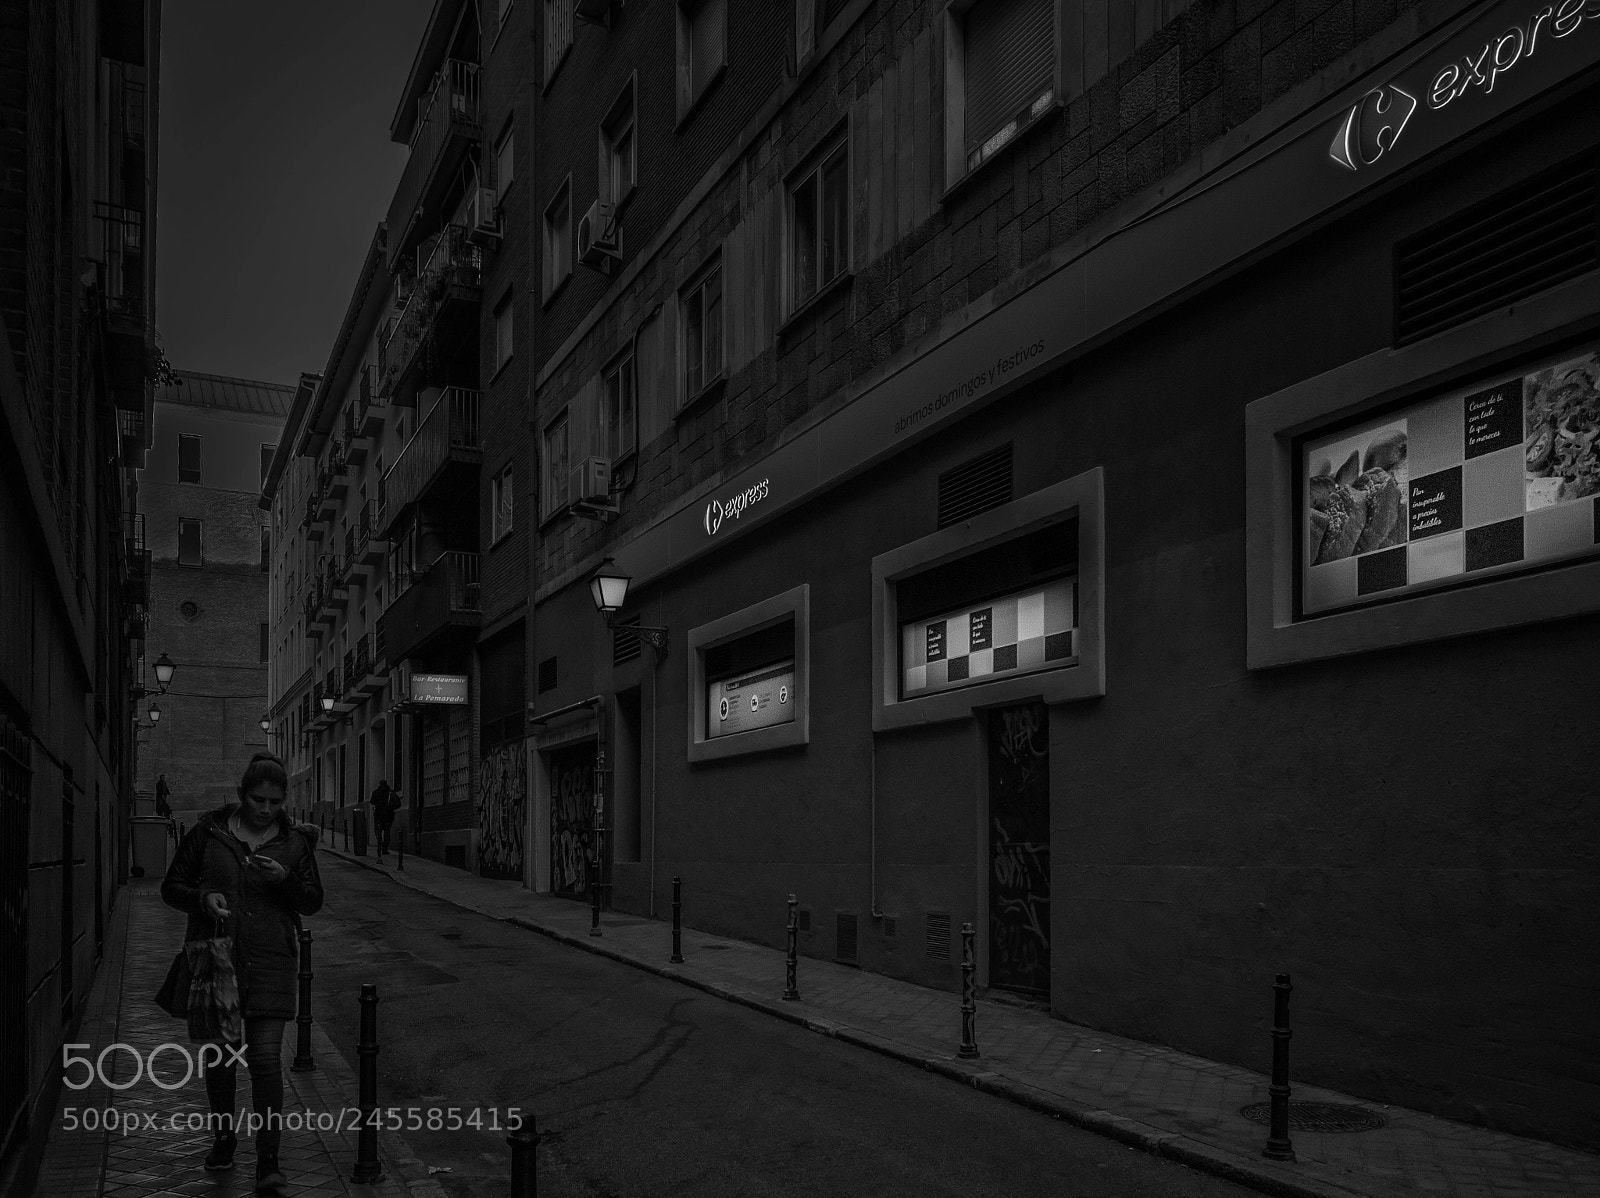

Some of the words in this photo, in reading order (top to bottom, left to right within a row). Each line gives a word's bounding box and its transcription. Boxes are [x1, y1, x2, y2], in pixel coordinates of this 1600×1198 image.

[1427, 0, 1600, 110] expre
[894, 401, 933, 434] abrimos
[934, 371, 987, 412] domingos
[987, 365, 996, 385] y
[996, 338, 1045, 376] festivos
[1469, 401, 1486, 412] Cerca
[1487, 395, 1496, 405] de
[1469, 415, 1480, 423] con
[1480, 407, 1495, 419] todo
[1476, 423, 1488, 434] que
[724, 478, 769, 519] express
[1412, 487, 1424, 497] Pan
